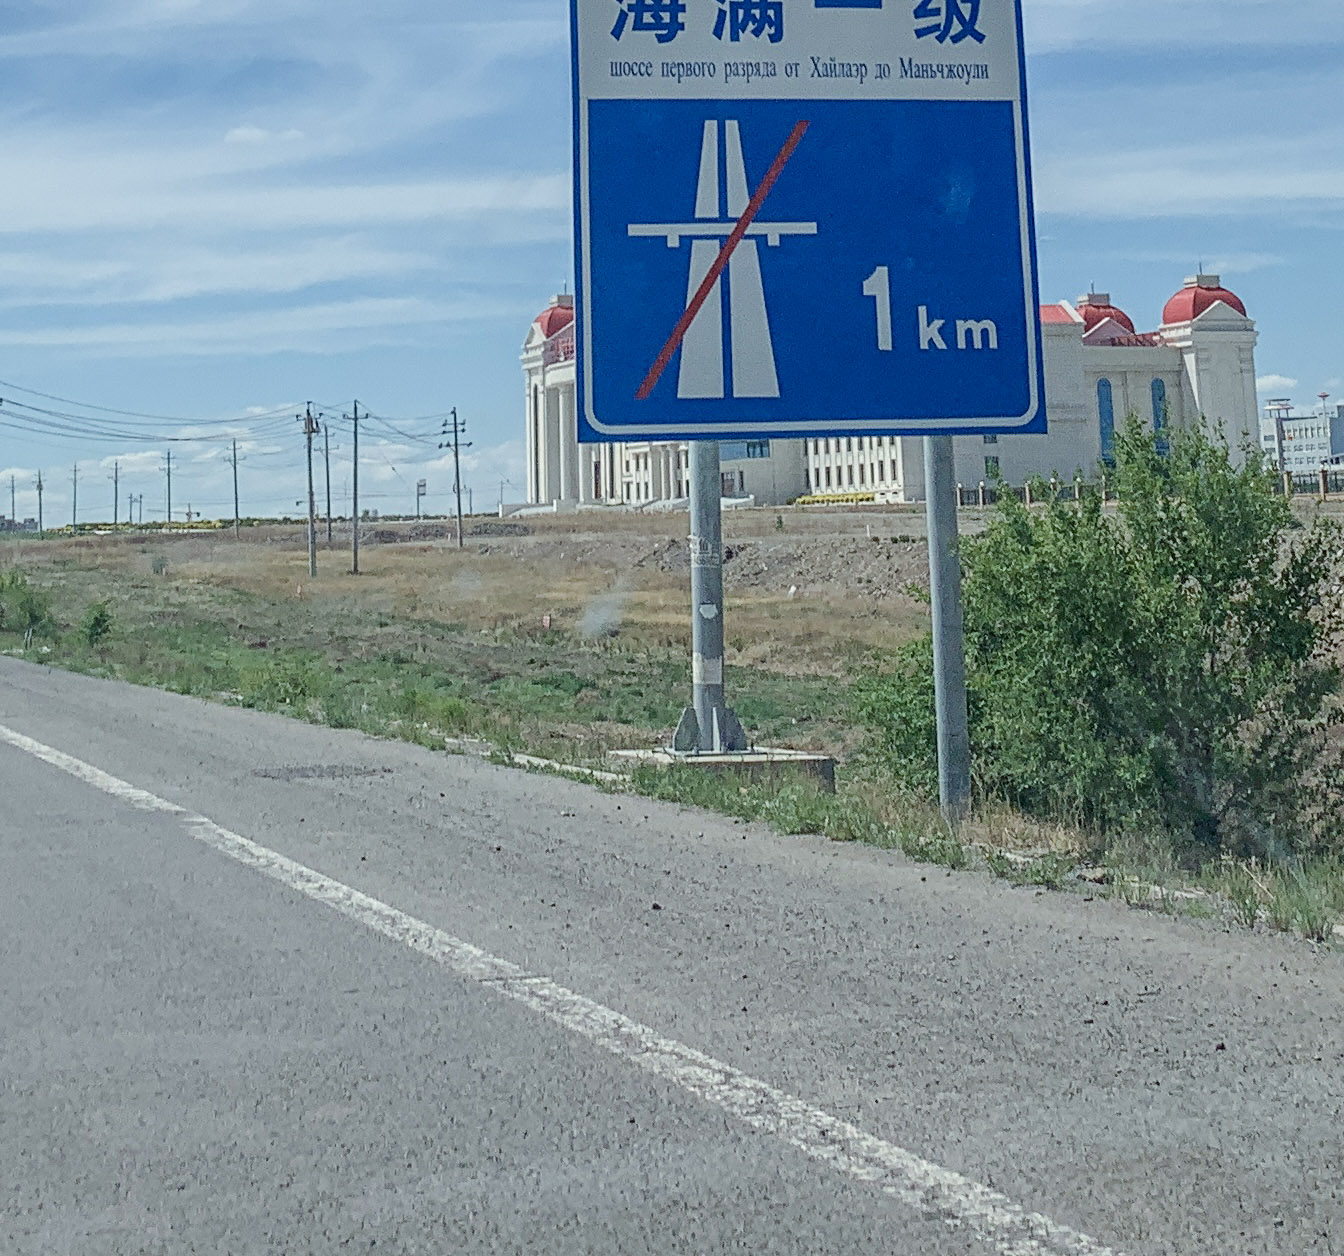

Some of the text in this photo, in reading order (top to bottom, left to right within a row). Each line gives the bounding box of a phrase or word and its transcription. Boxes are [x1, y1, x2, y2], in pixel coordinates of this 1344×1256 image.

[610, 56, 990, 86] шоссе первого разряда от Хайлаэр до Маньчжоули
[863, 266, 999, 351] 1 km
